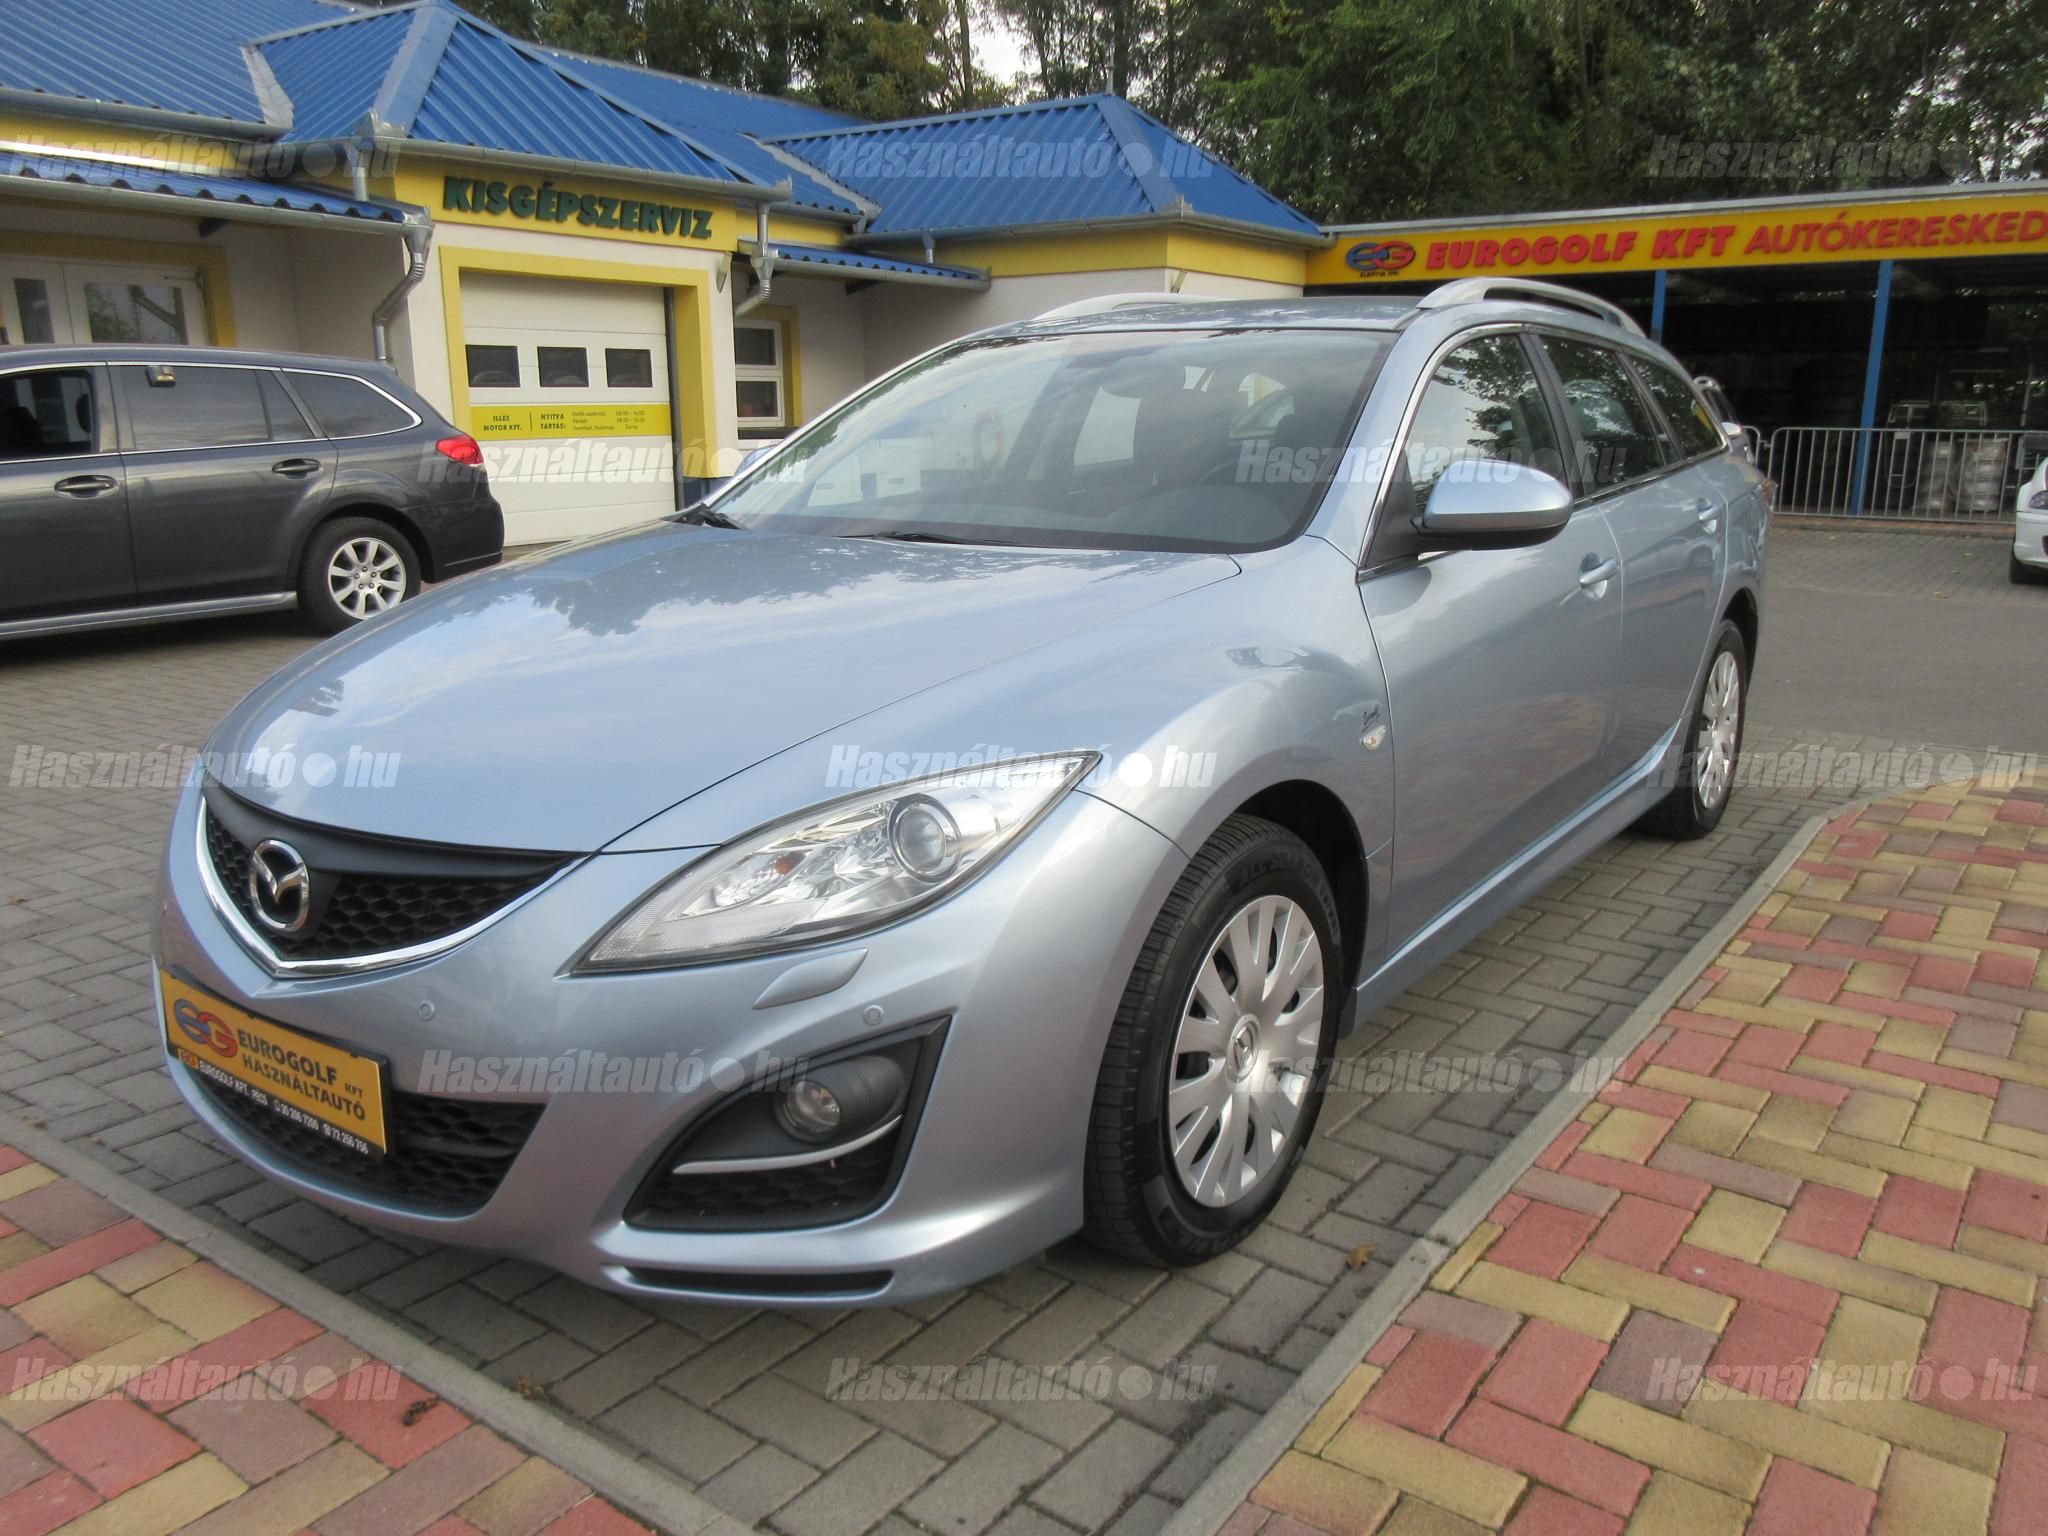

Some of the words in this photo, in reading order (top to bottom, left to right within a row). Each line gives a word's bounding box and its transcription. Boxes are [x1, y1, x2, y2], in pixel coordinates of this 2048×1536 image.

[444, 175, 714, 239] KISGÉPSZERVIZ
[1425, 231, 1638, 270] EUROGOLF
[1651, 225, 1735, 259] KFT
[1744, 210, 2048, 256] AUTÓKERESKED
[237, 1028, 337, 1085] EUROGOLF
[345, 1082, 363, 1098] KFT
[242, 1053, 366, 1121] HASZNÁLTAUTÓ
